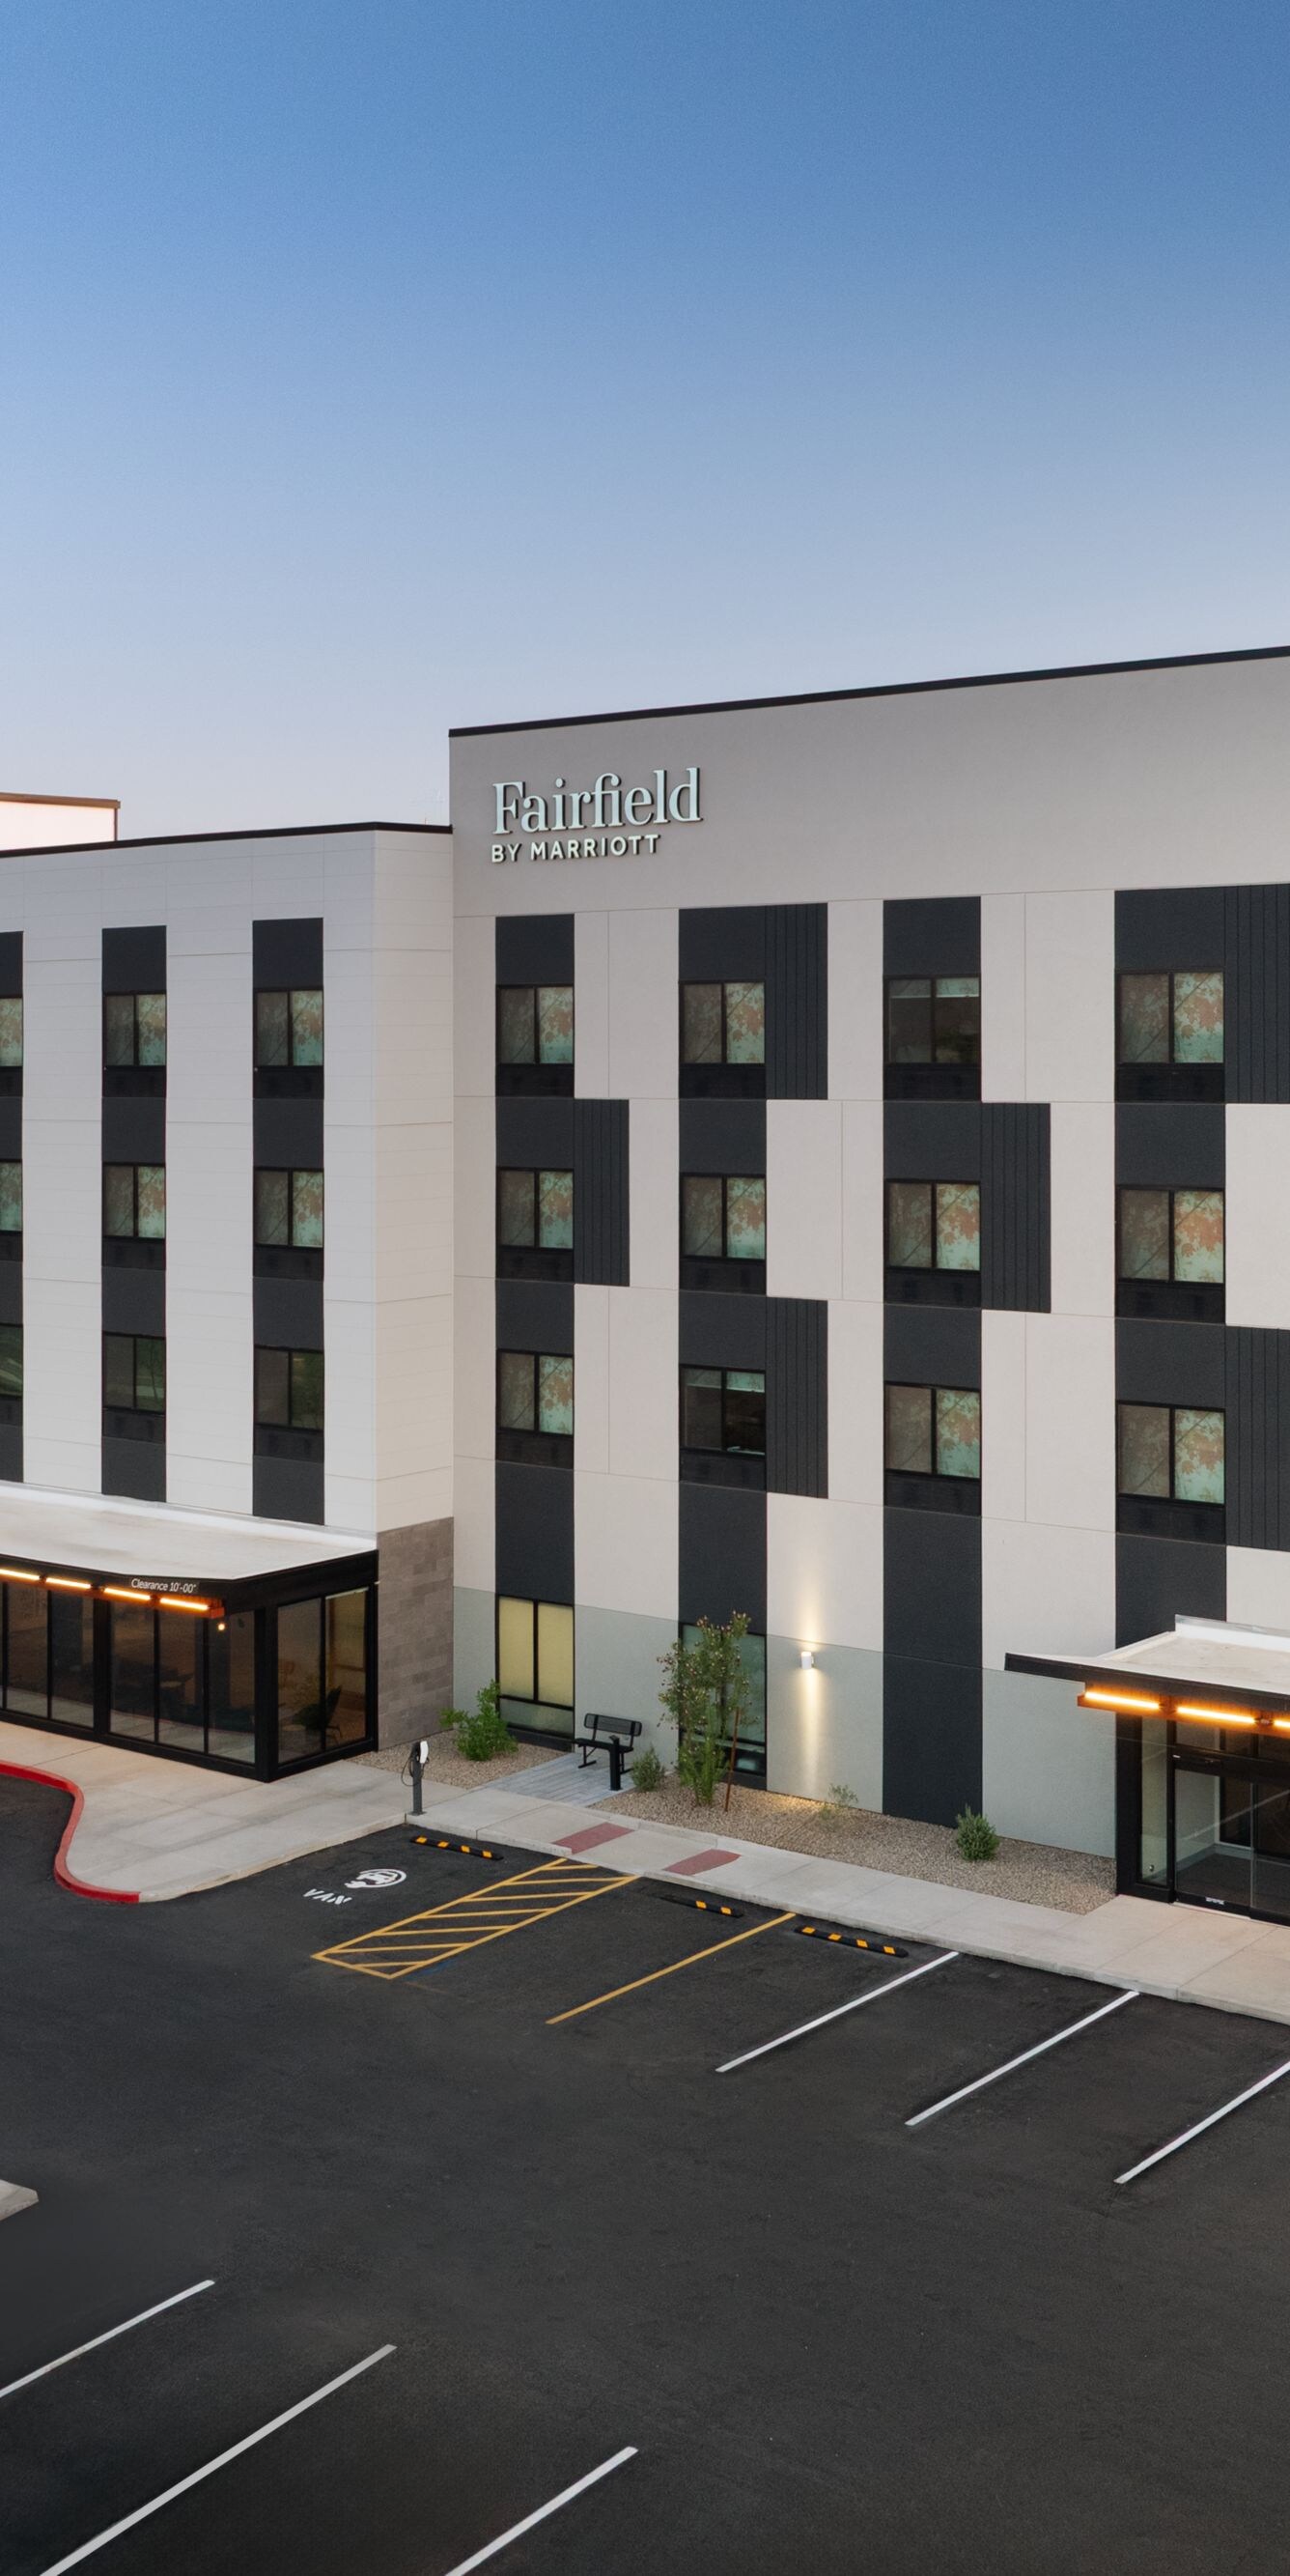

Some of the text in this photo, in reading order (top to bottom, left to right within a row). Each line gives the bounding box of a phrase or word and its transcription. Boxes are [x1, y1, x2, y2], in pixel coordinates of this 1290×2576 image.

[492, 767, 703, 835] Fairfield
[491, 834, 660, 863] BY MARRIOTT
[130, 1578, 169, 1592] Clearance
[302, 1888, 352, 1905] VAN
